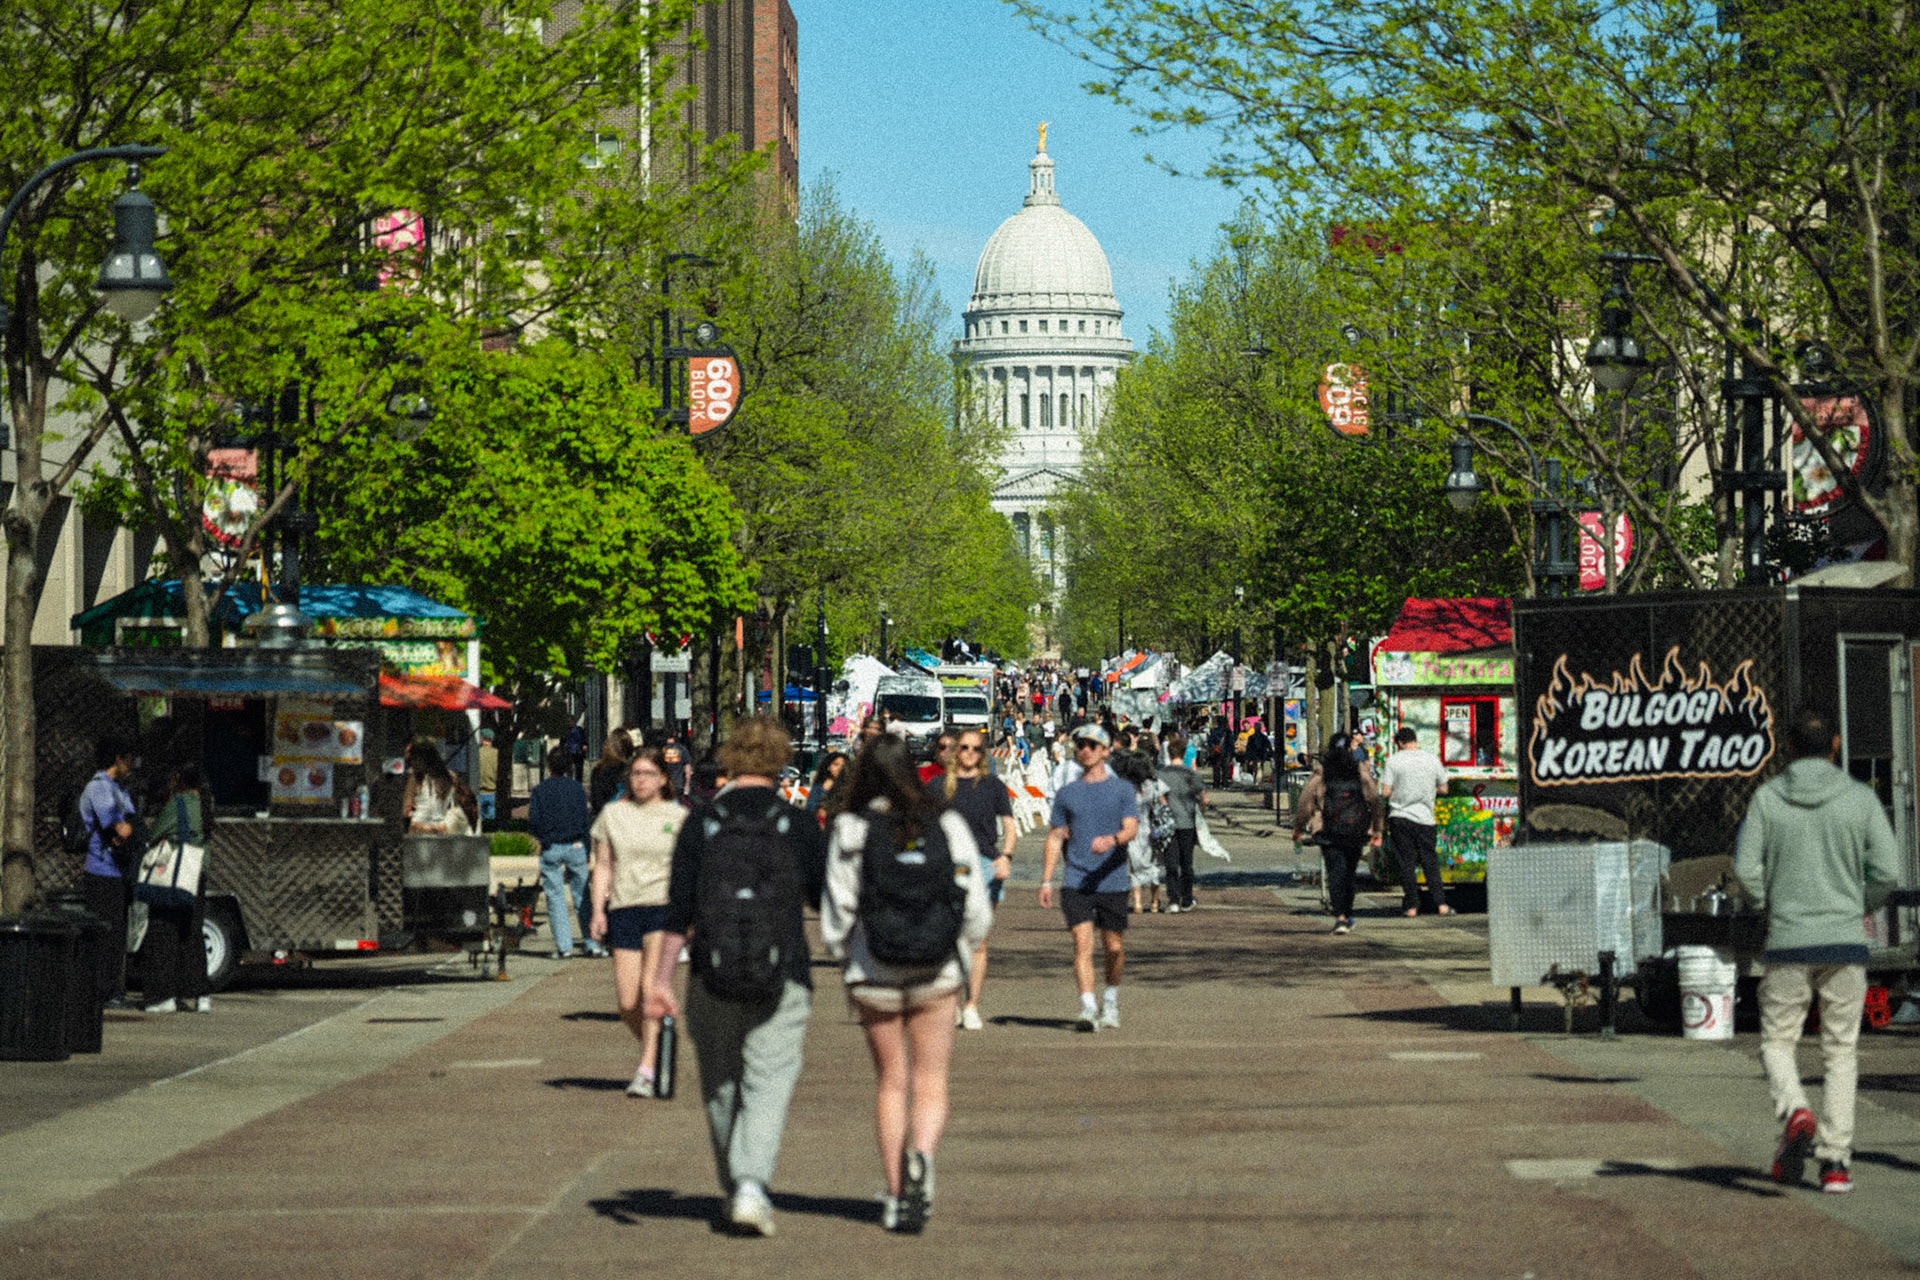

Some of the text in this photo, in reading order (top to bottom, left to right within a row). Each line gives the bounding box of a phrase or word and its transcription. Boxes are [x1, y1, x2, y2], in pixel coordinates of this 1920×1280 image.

[691, 370, 706, 420] BLOCK
[706, 358, 733, 422] 600
[1581, 690, 1720, 731] BULGOGI
[1537, 729, 1766, 778] KOREAN TACO
